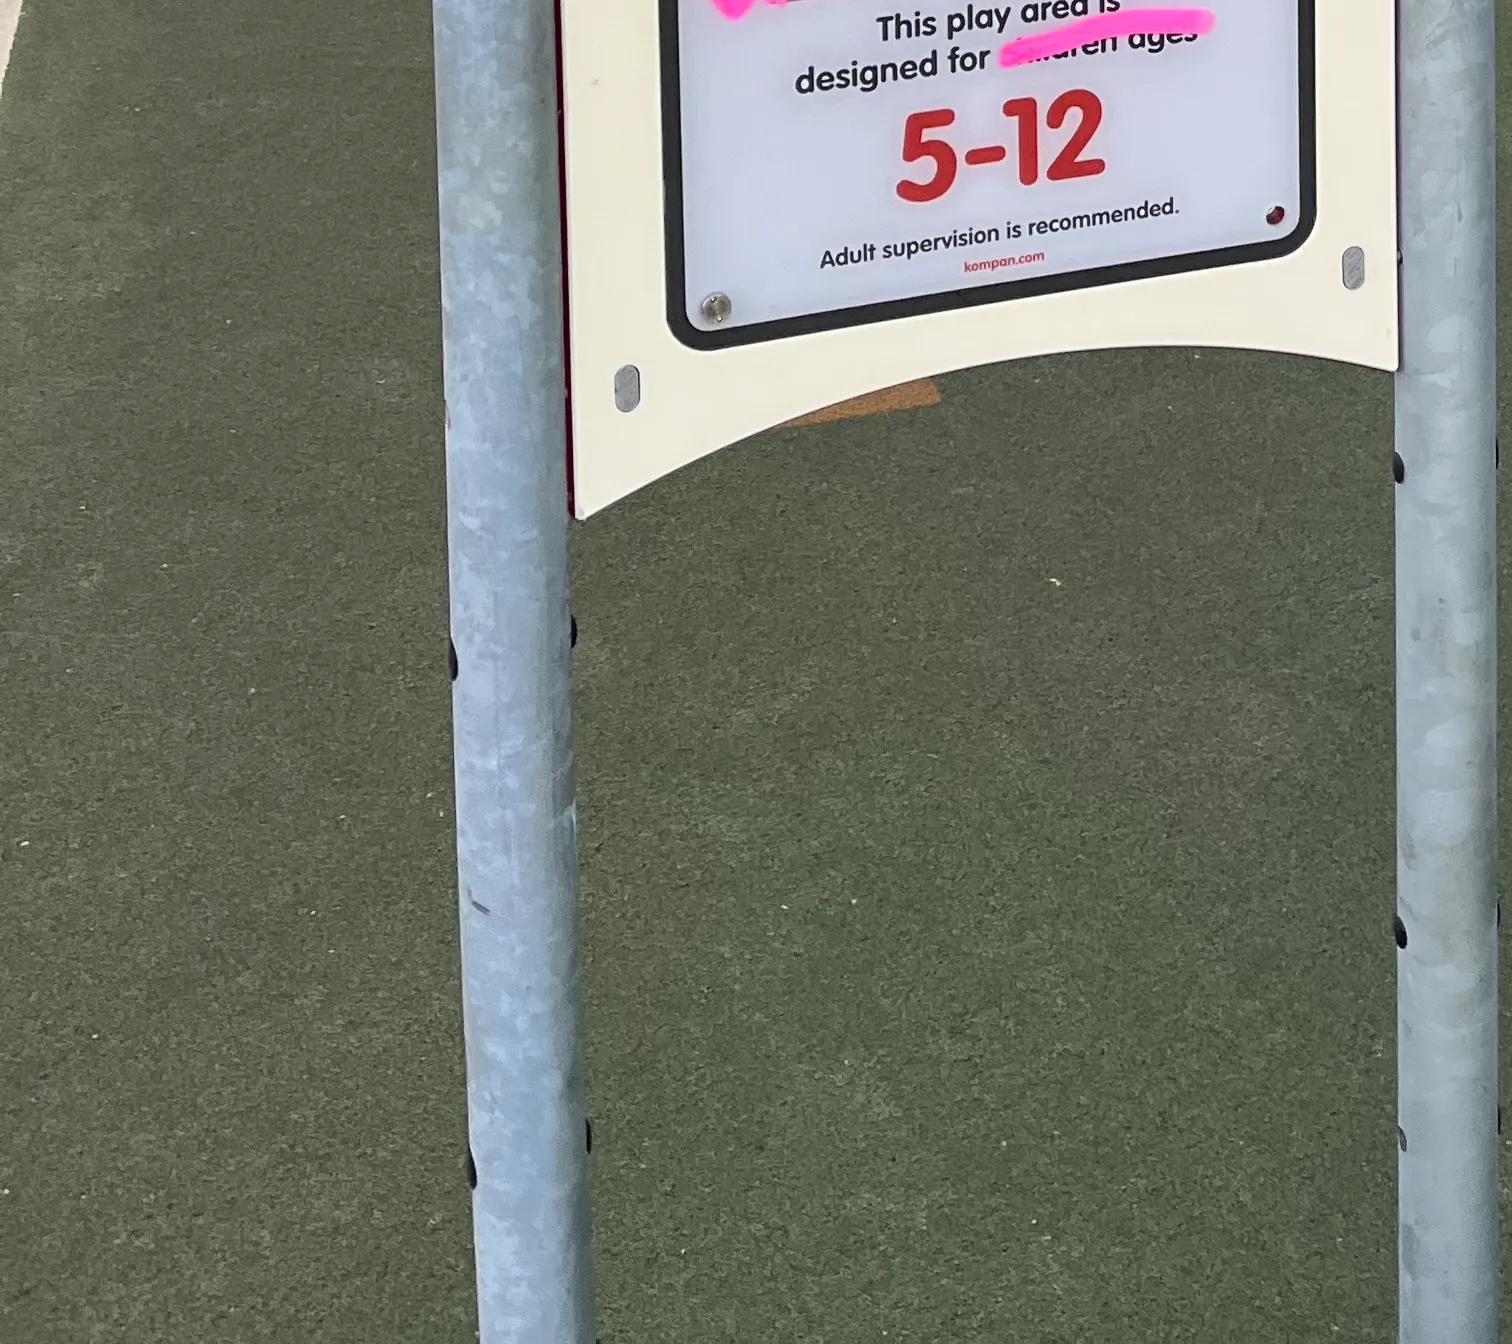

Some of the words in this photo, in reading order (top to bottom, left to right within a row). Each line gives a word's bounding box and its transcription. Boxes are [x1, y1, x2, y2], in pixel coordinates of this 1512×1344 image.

[875, 10, 938, 43] This
[946, 2, 1013, 41] play
[795, 47, 939, 95] designed
[946, 46, 992, 75] for
[895, 87, 1107, 204] 5-12
[819, 242, 878, 269] Adult
[881, 227, 1001, 260] supervision
[1006, 223, 1023, 240] is
[1027, 196, 1181, 236] recommended.
[962, 250, 1046, 274] kompan.com
